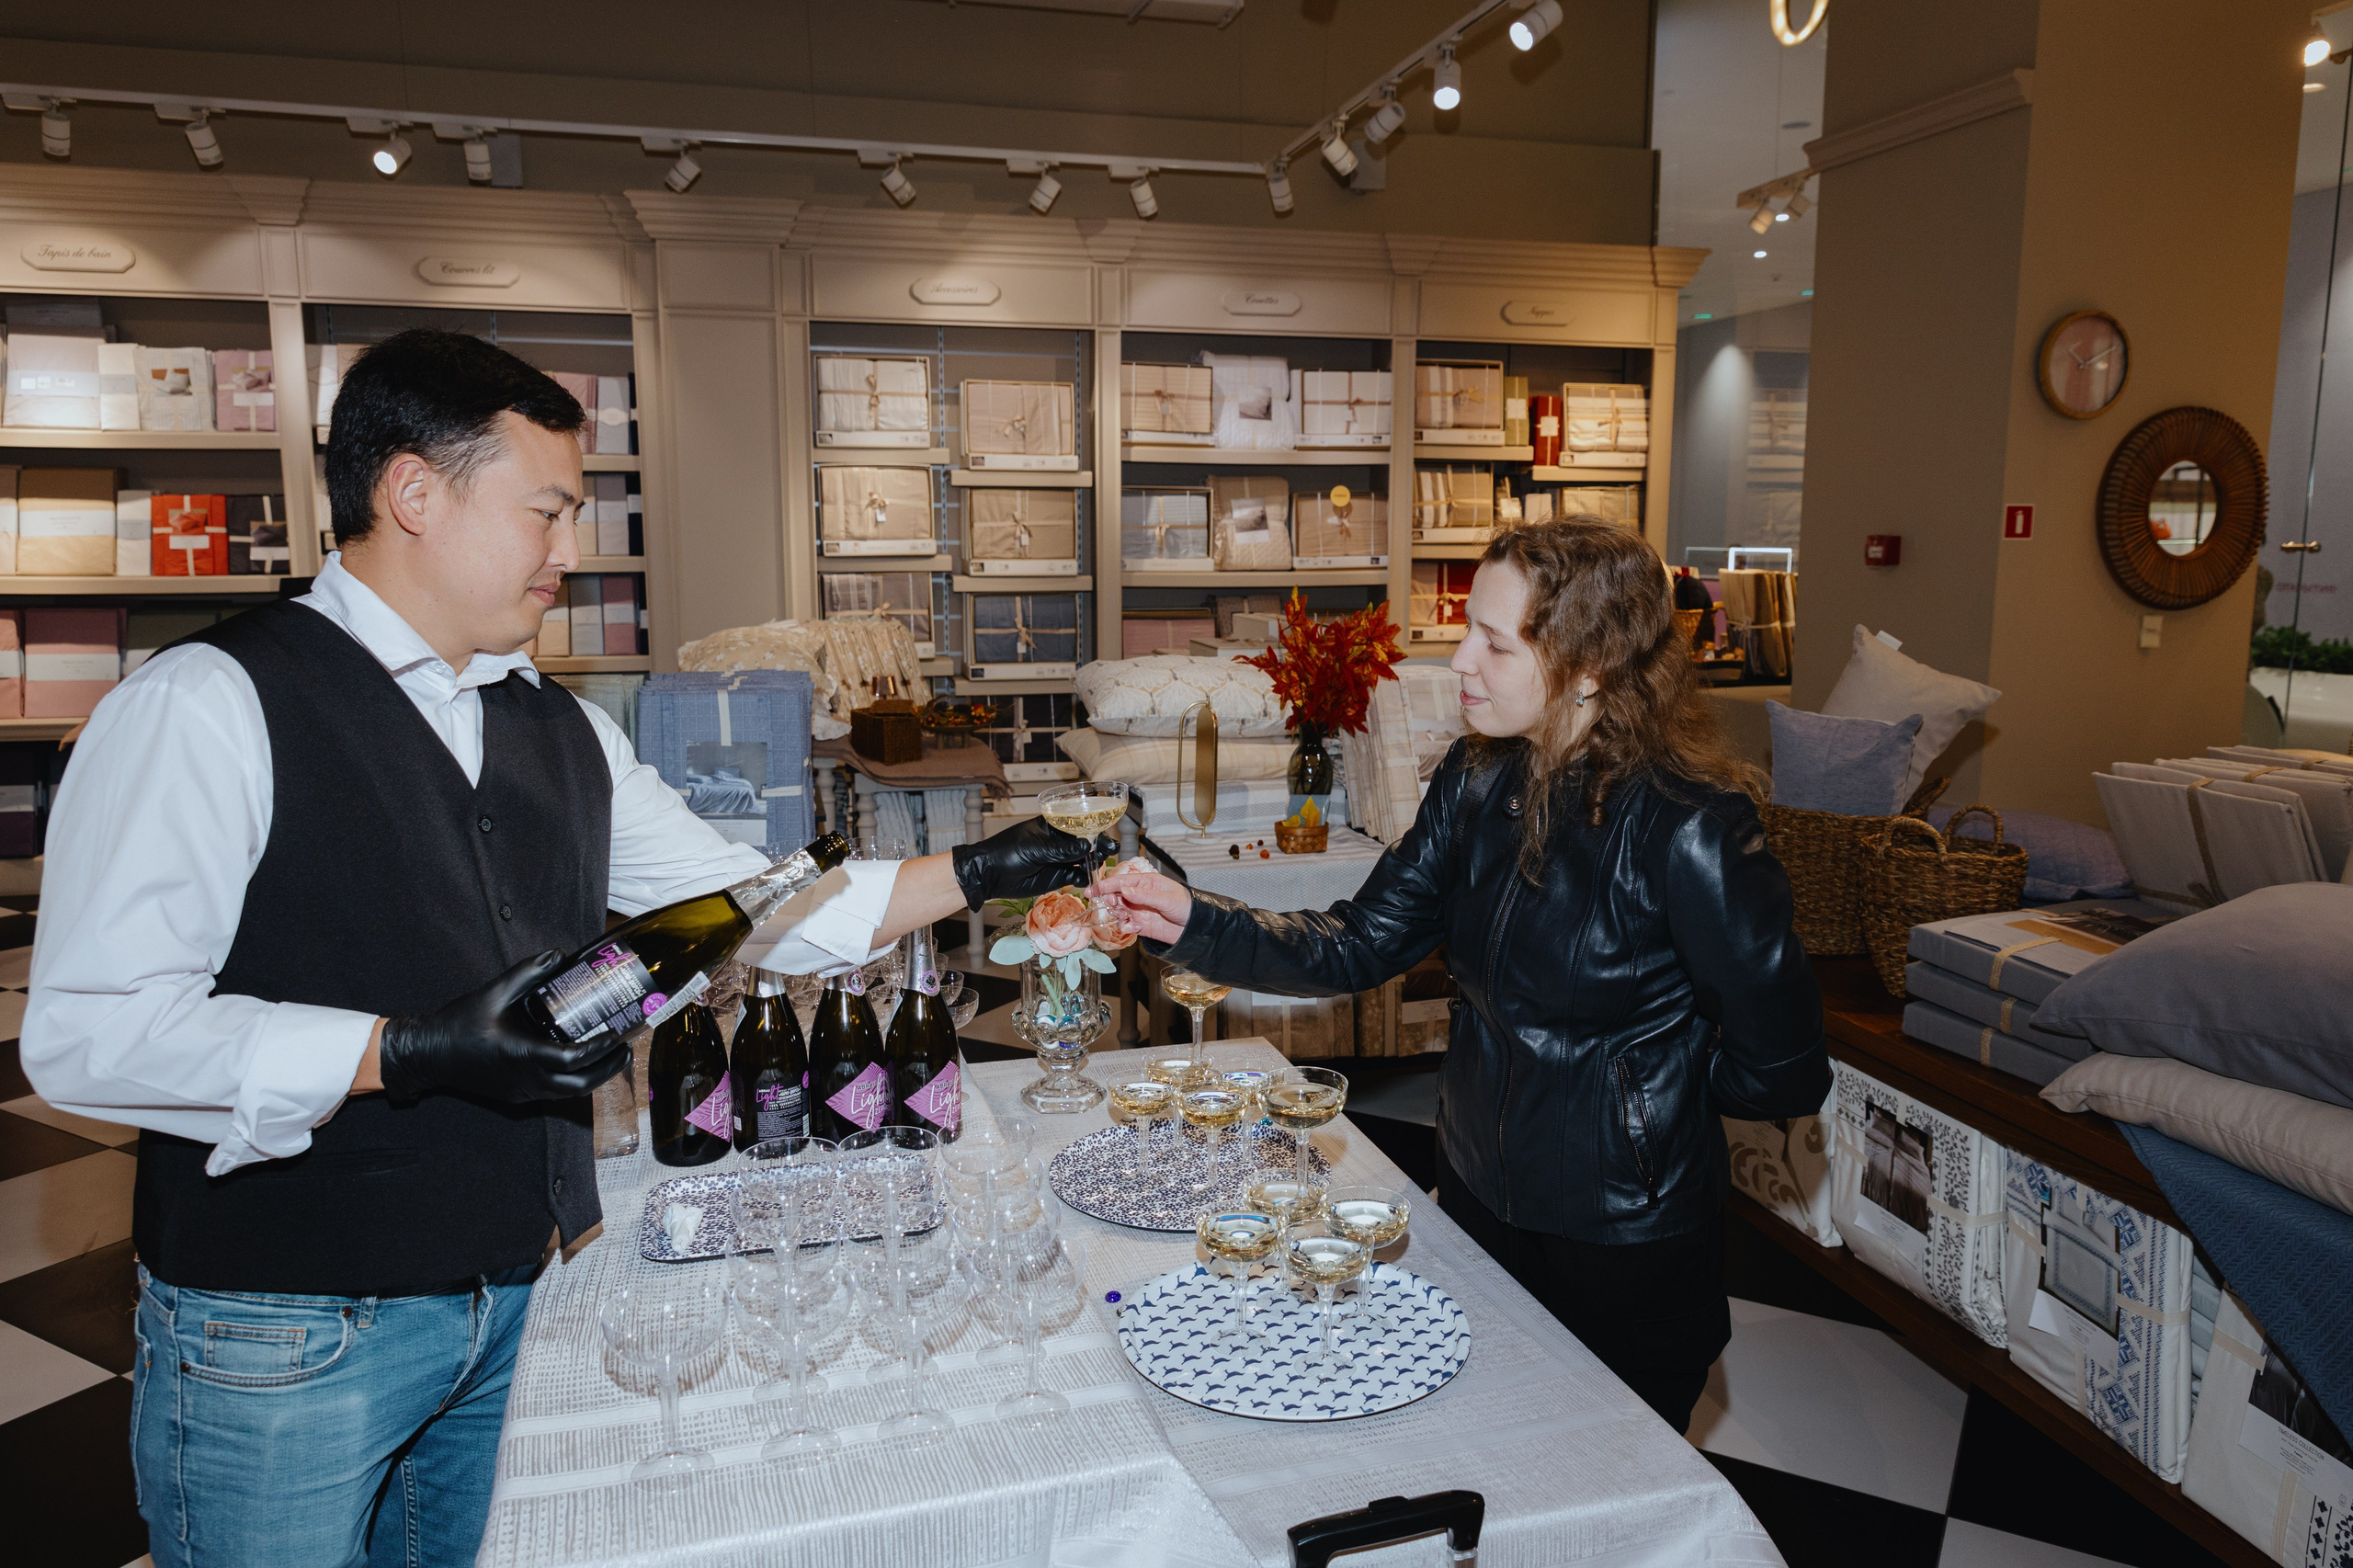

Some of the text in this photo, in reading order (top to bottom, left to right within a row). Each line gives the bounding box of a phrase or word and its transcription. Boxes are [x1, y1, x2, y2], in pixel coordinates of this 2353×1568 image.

[72, 246, 84, 257] de
[591, 942, 636, 967] Light
[756, 1083, 784, 1111] Light
[2279, 1426, 2298, 1444] TIMELESS
[2298, 1439, 2325, 1460] COLLECTION
